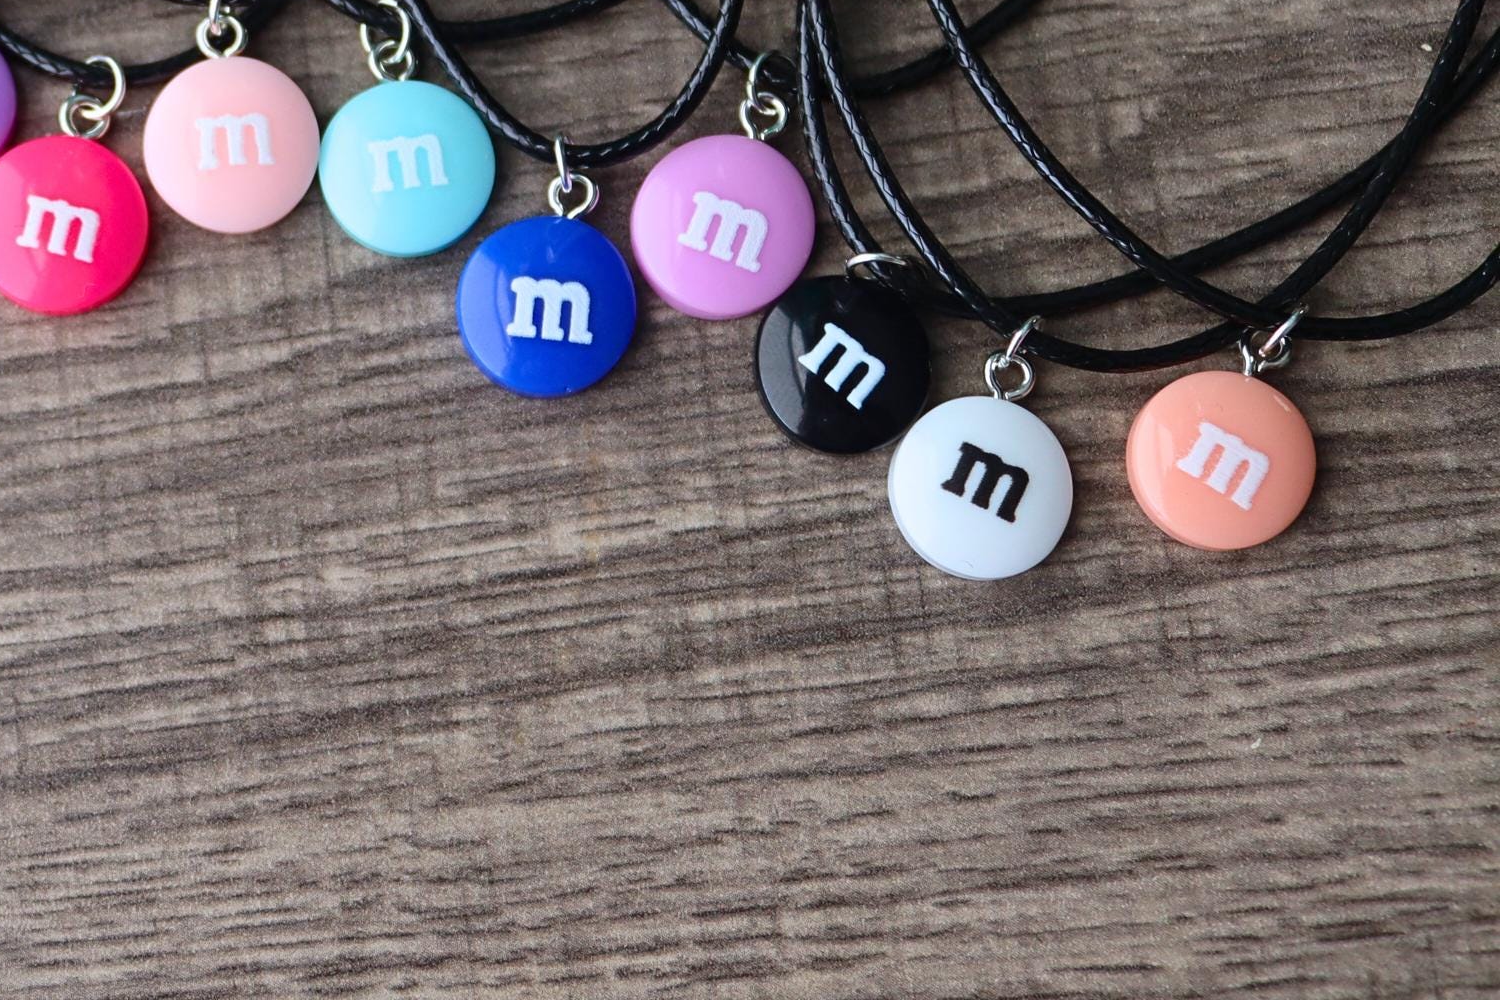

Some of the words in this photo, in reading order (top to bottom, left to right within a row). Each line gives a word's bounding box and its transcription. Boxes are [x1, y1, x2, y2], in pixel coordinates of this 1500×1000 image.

[194, 112, 274, 169] m
[367, 134, 448, 191] m
[16, 195, 100, 263] m
[678, 192, 768, 273] m
[506, 276, 593, 345] m
[798, 322, 885, 410] m
[940, 441, 1030, 522] m
[1176, 422, 1269, 510] m
